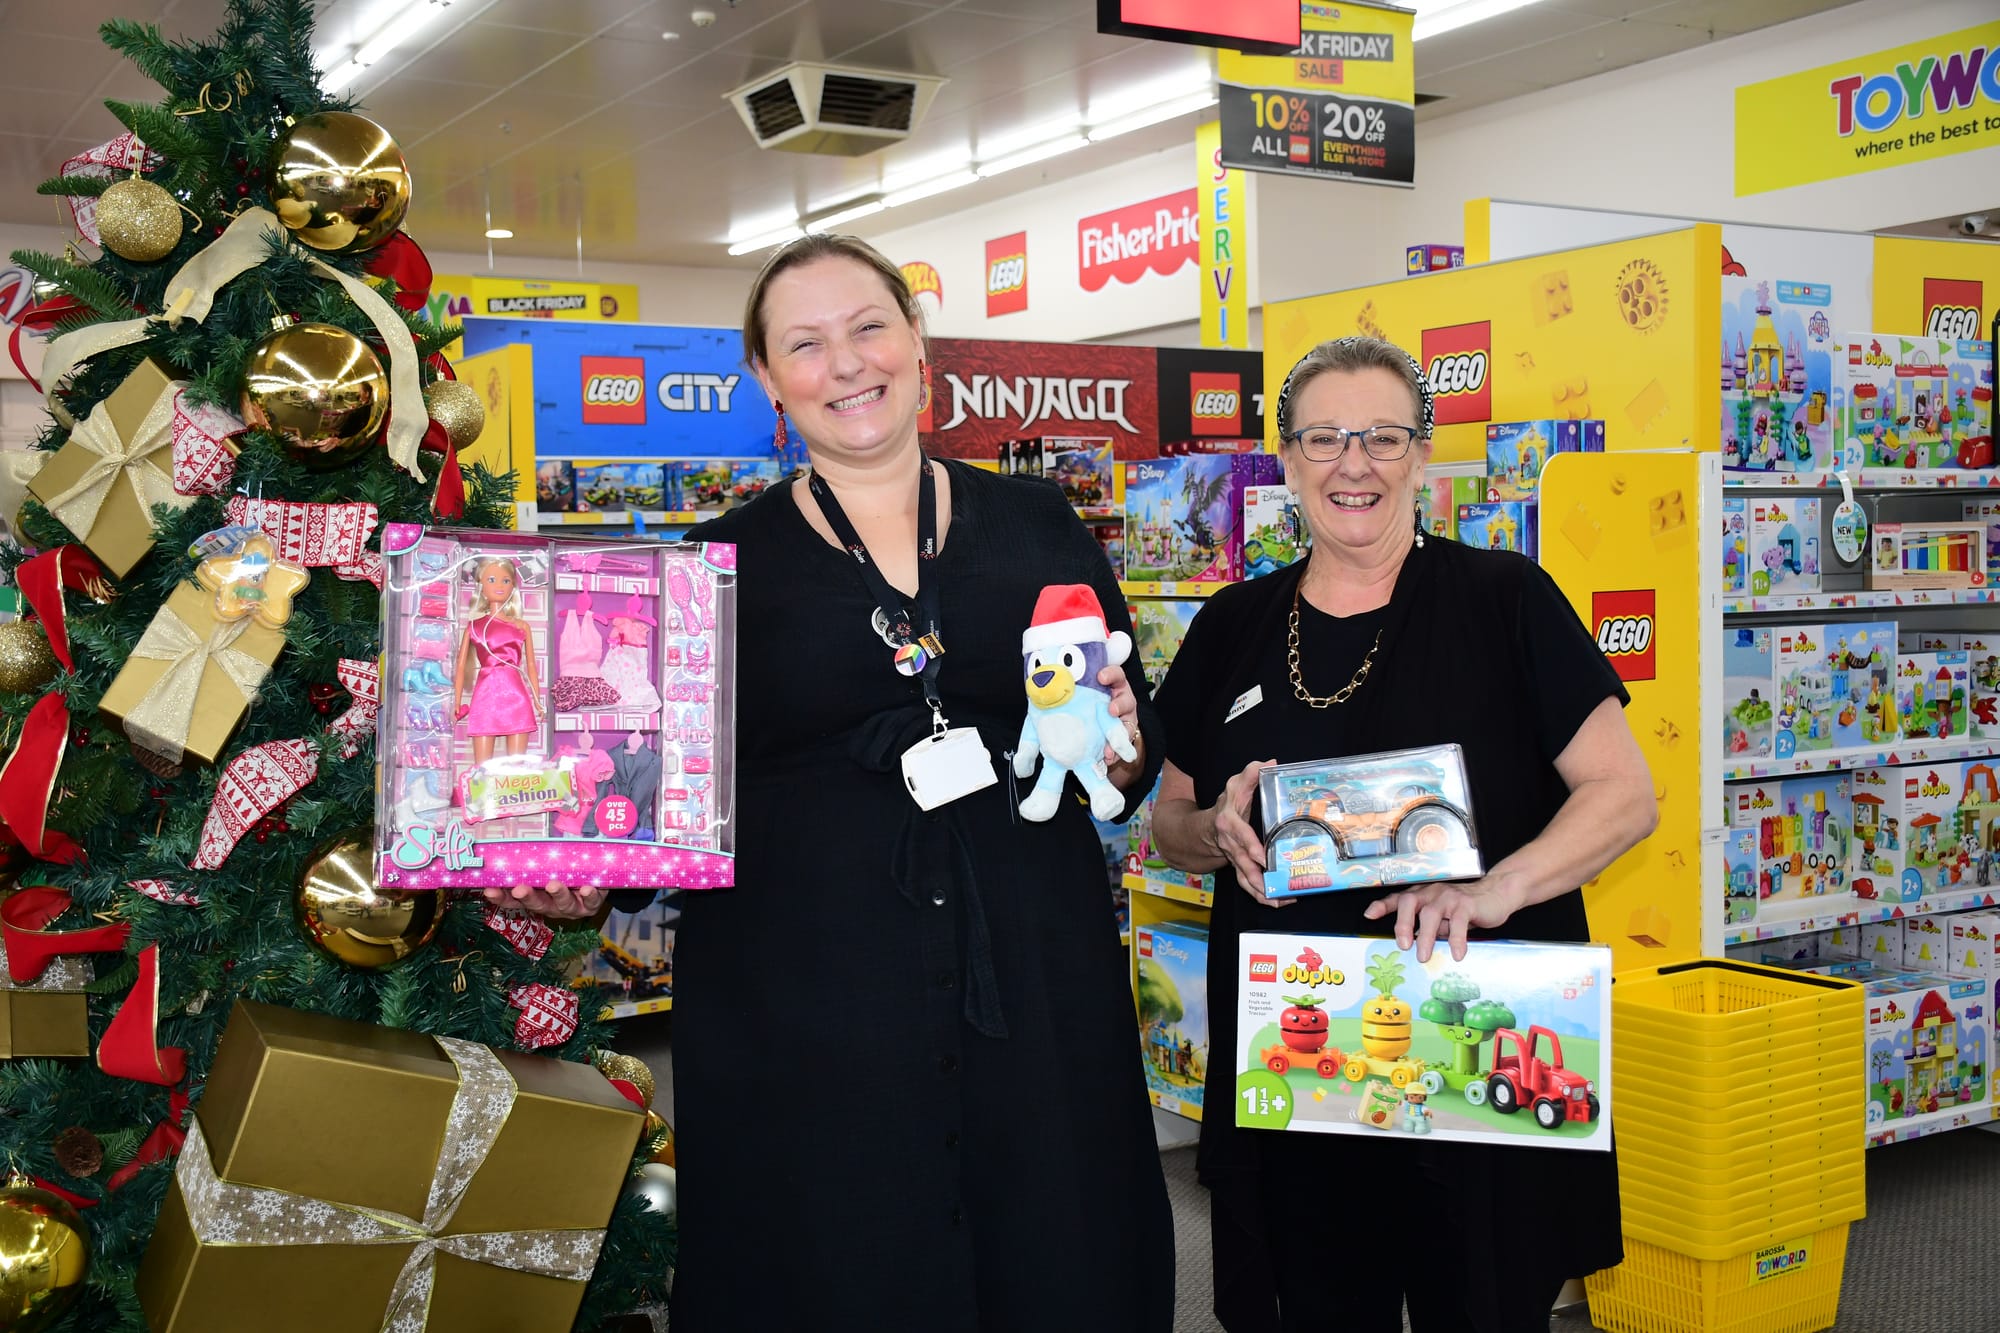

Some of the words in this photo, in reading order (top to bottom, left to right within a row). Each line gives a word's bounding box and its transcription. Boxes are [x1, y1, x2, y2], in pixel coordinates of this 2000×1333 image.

[1318, 34, 1389, 59] FRIDAY
[1299, 62, 1338, 80] SALE
[1250, 92, 1310, 131] 10%
[1288, 122, 1310, 133] OFF
[1323, 102, 1386, 141] 20%
[1364, 131, 1386, 143] OFF
[1855, 137, 1903, 158] where
[1909, 131, 1936, 147] the
[1941, 119, 1979, 141] best
[1251, 135, 1288, 157] ALL
[1323, 140, 1387, 157] EVERYTHING
[1323, 152, 1345, 164] ELSE
[1346, 155, 1387, 168] IN-STORE
[1082, 205, 1199, 269] Fisher-Pric
[988, 258, 1025, 292] LEGO
[489, 298, 535, 312] BLACK
[537, 295, 586, 311] FRIDAY
[1927, 307, 1979, 340] LEGO
[1865, 352, 1892, 368] duplo
[1428, 354, 1486, 394] LEGO
[586, 376, 642, 403] LEGO
[658, 373, 740, 413] CITY
[940, 374, 1140, 434] NINJAGO
[1195, 392, 1239, 414] LEGO
[1498, 425, 1520, 437] Disney
[1846, 449, 1862, 466] 2+
[1138, 464, 1165, 480] Disney
[1262, 489, 1289, 503] Disney
[1469, 505, 1490, 517] Disney
[1837, 526, 1852, 535] NEW
[1598, 617, 1651, 653] LEGO
[1794, 641, 1817, 653] duplo
[1780, 738, 1793, 753] 2+
[495, 776, 541, 790] Mega
[1920, 782, 1951, 799] duplo
[606, 801, 628, 809] over
[1751, 798, 1774, 810] duplo
[605, 809, 627, 822] 45
[608, 822, 627, 831] pcs.
[394, 822, 473, 869] Steffi
[387, 873, 400, 883] 3+
[1290, 862, 1327, 878] TRUCKS
[1903, 878, 1919, 896] 2+
[1154, 935, 1189, 965] Disney
[1252, 962, 1276, 974] LEGO
[1281, 963, 1345, 989] duplo
[1883, 1010, 1906, 1023] duplo
[1868, 1109, 1881, 1122] 2+
[1755, 1244, 1786, 1260] BAROSSA
[1755, 1249, 1807, 1276] TOYWORLD
